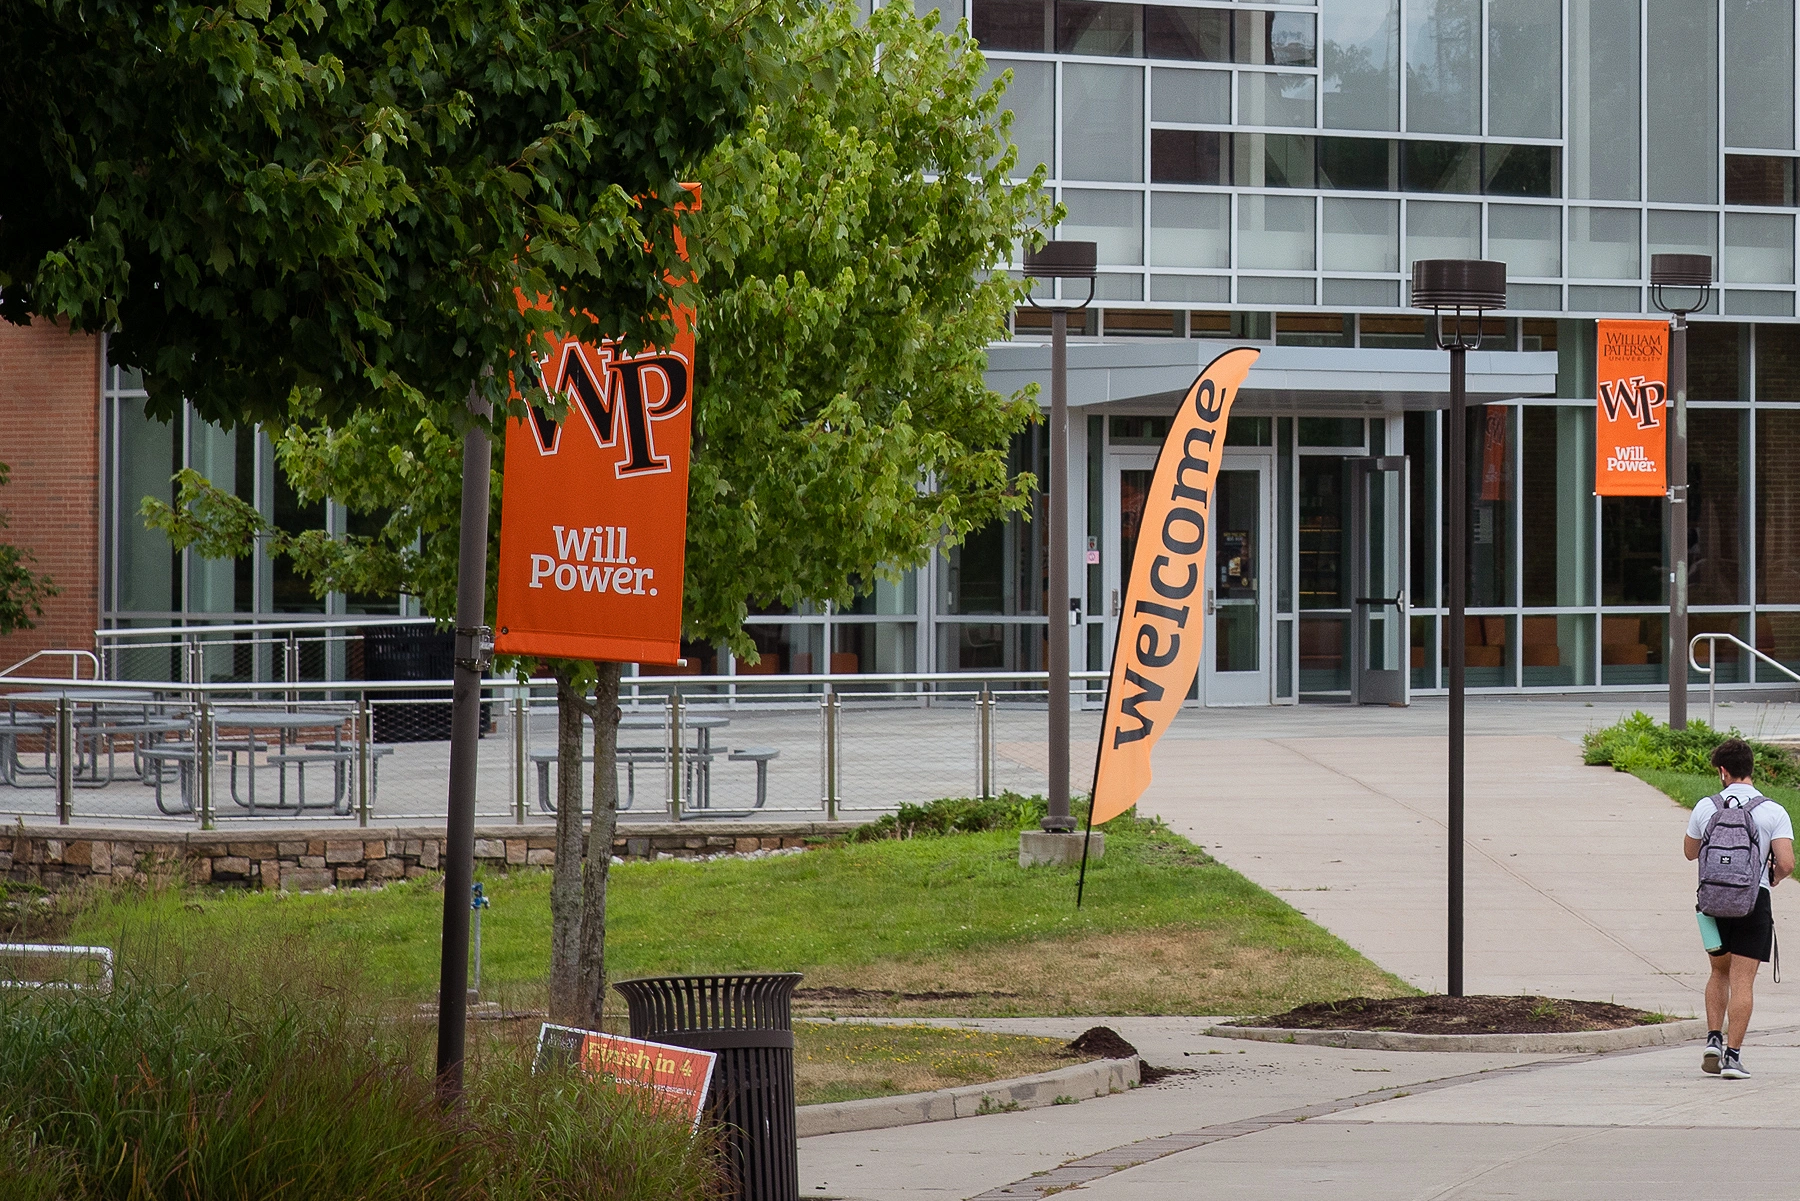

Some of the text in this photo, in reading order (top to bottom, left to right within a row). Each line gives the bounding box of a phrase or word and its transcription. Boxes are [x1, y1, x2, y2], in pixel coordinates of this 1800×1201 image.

[1604, 344, 1663, 357] PATERSON
[1606, 332, 1661, 346] WILLIAM
[518, 337, 689, 479] WP
[1599, 375, 1666, 430] WP
[1607, 458, 1657, 472] Power.
[1614, 446, 1648, 461] Will.
[552, 524, 637, 565] Will.
[1113, 377, 1226, 750] welcome
[529, 553, 658, 597] Power.
[588, 1041, 650, 1071] Finish
[653, 1053, 676, 1075] in
[679, 1059, 693, 1077] 4
